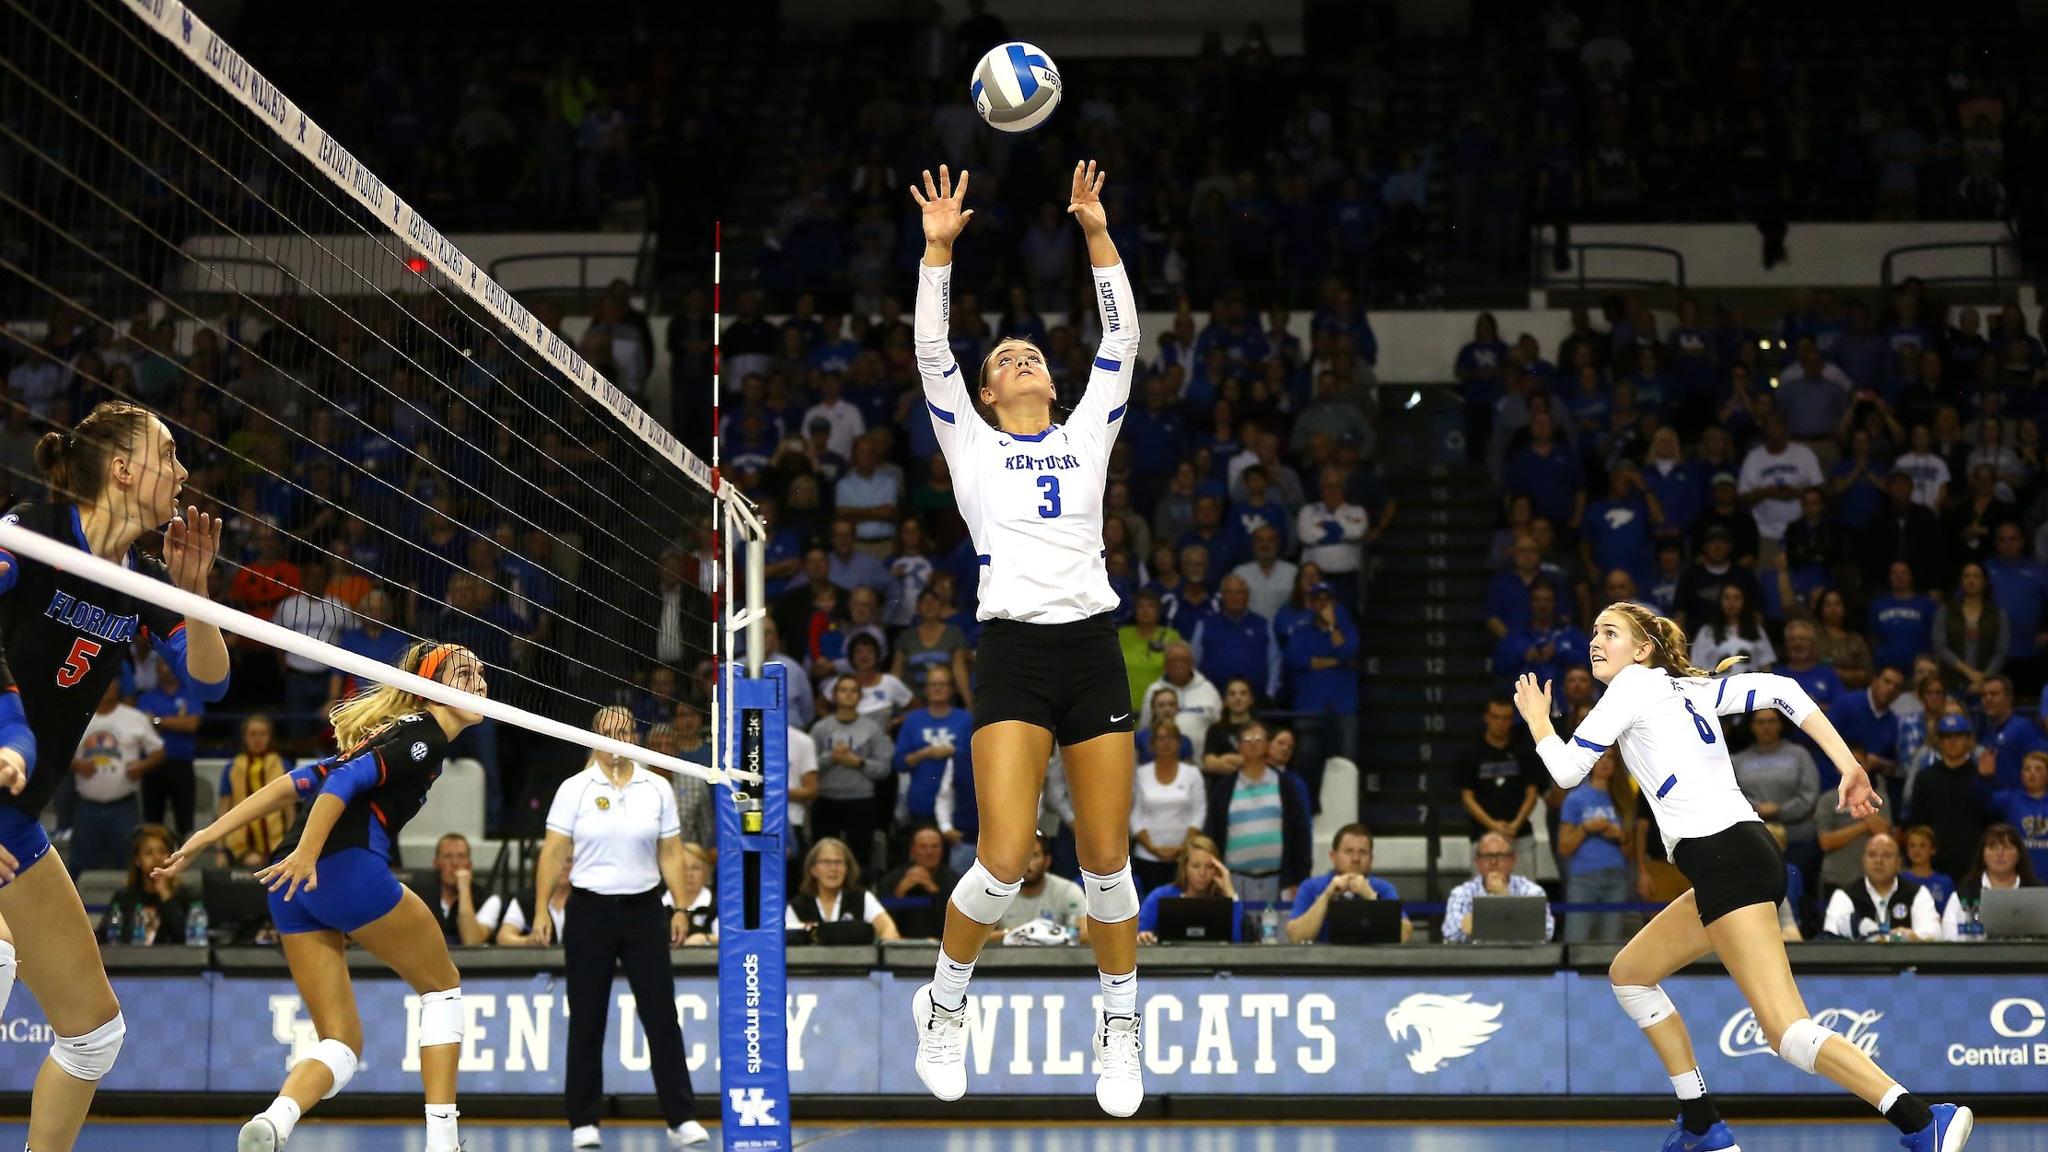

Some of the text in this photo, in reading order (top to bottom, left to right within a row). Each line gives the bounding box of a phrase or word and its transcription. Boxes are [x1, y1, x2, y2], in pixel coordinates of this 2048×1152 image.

[1099, 281, 1120, 333] WILDCATS
[1037, 475, 1061, 518] 3
[56, 637, 101, 688] 5
[1425, 658, 1446, 675] 12
[1425, 686, 1442, 701] 11
[1424, 714, 1445, 732] 10
[1684, 697, 1716, 744] 6
[1417, 805, 1429, 824] 7
[743, 954, 762, 1073] sports imports
[966, 994, 1335, 1075] WILCATS
[1948, 1043, 2029, 1066] Central
